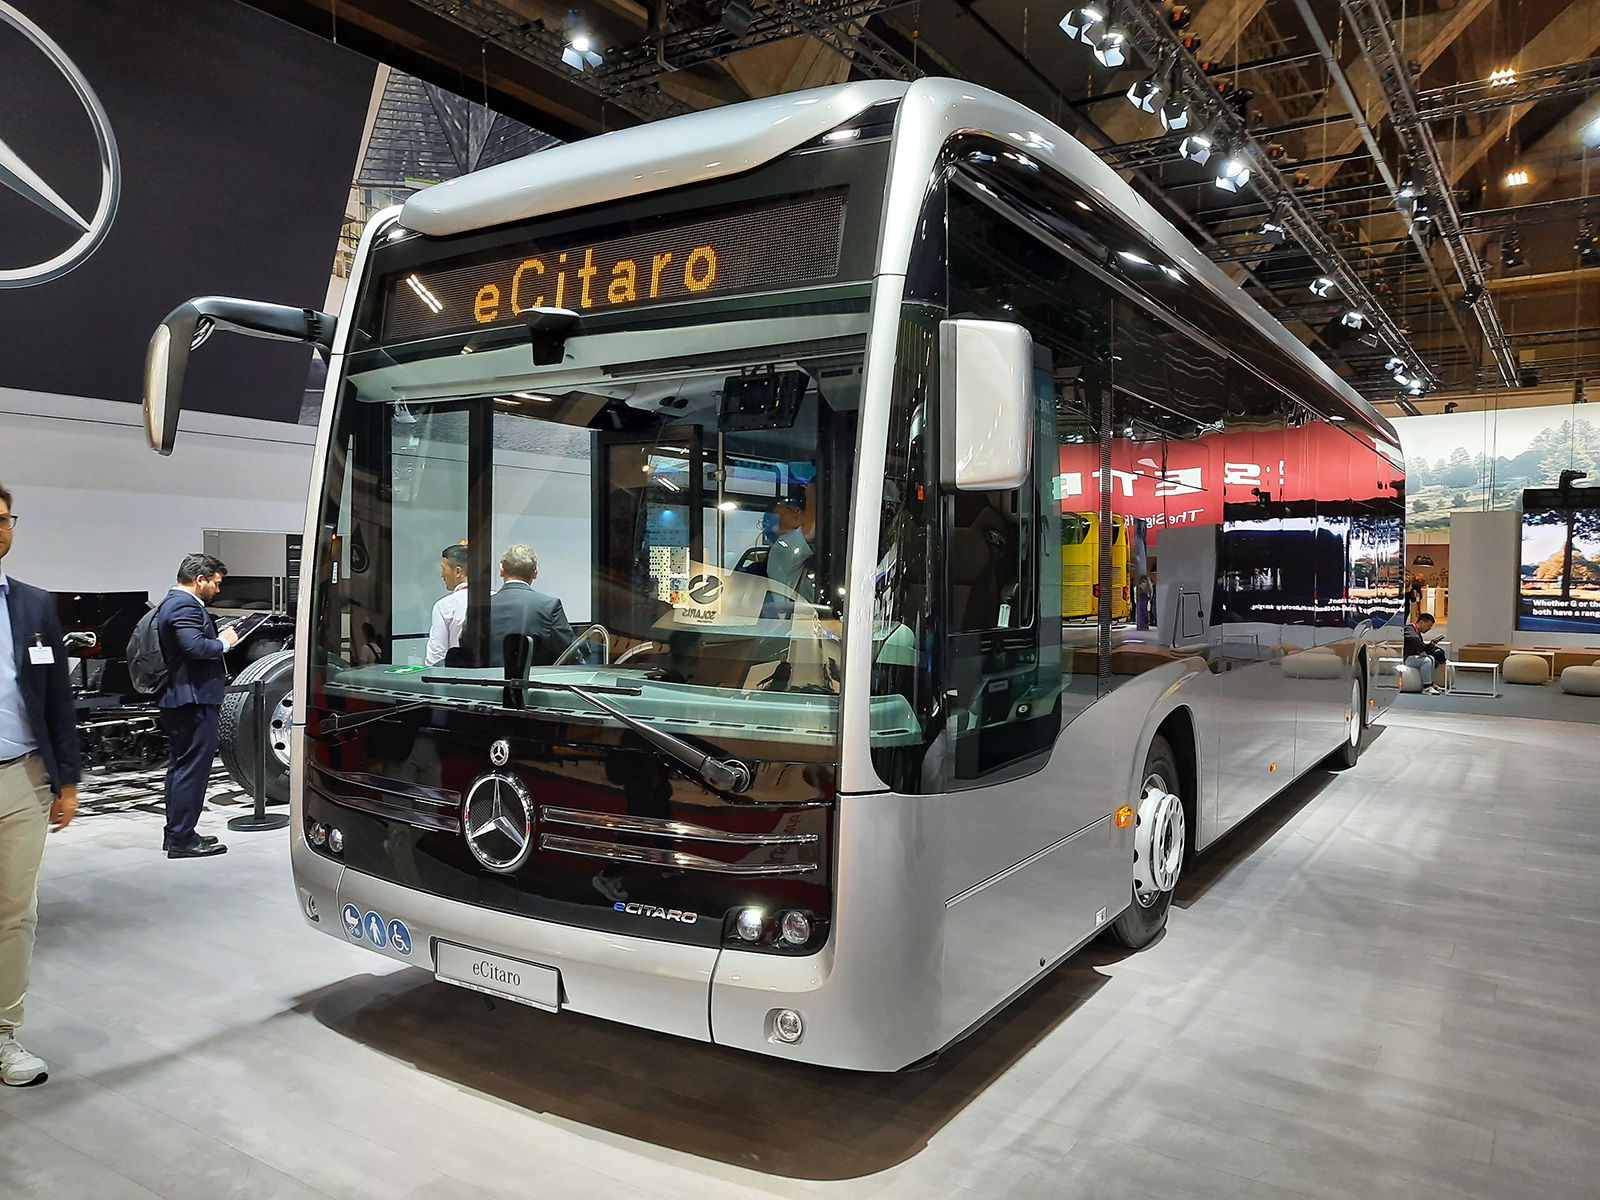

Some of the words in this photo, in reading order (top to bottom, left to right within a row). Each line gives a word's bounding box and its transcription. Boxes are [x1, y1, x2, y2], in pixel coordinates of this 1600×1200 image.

[474, 245, 718, 324] eCitaro
[1532, 608, 1552, 616] both
[472, 960, 521, 987] eCitaro
